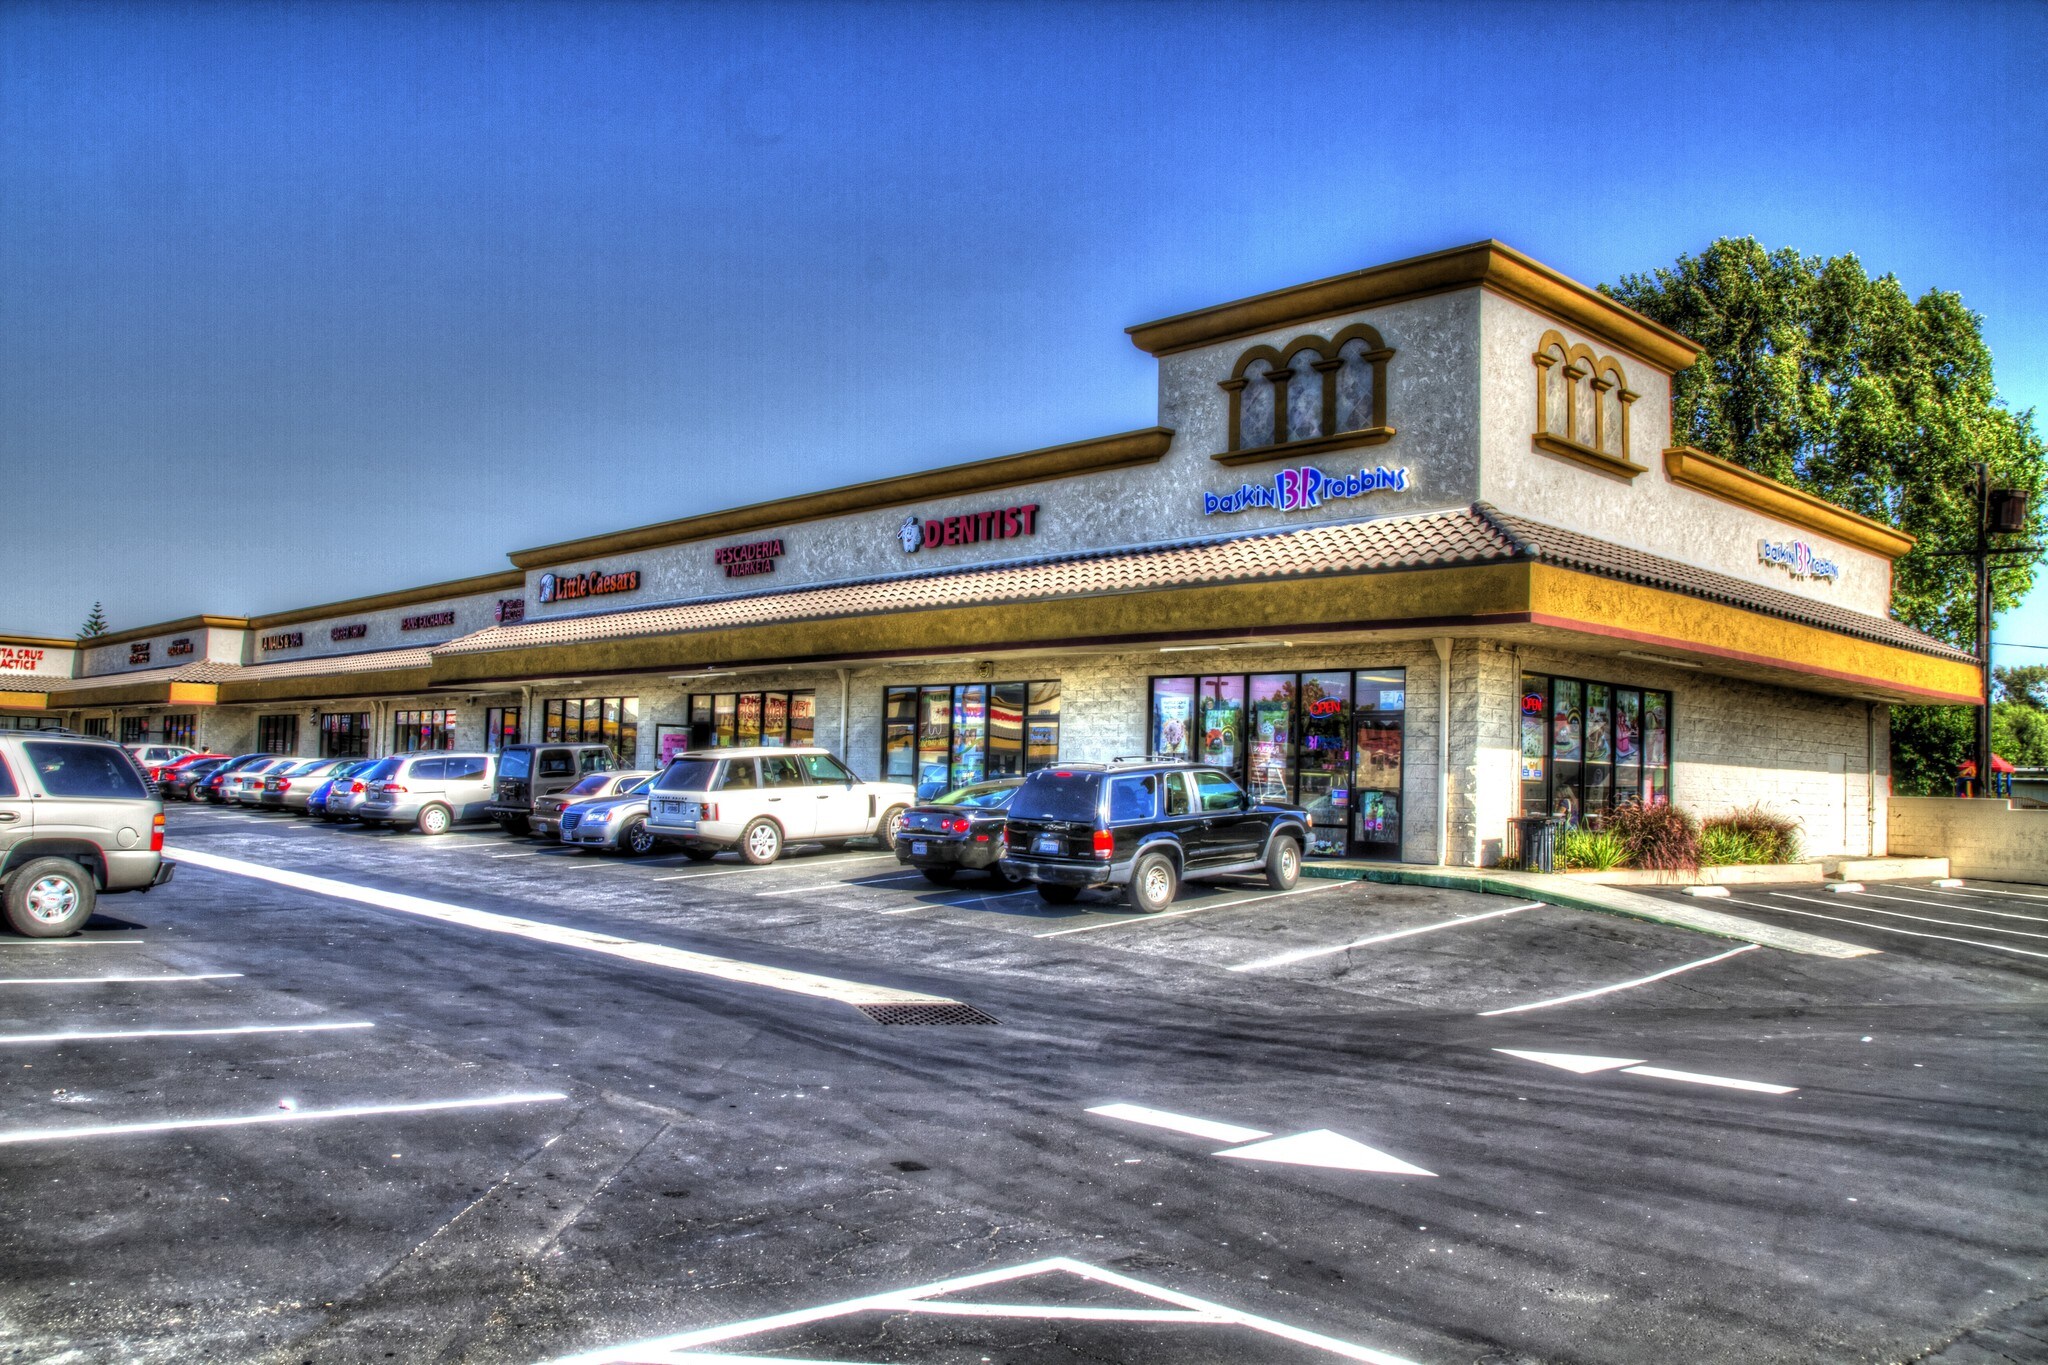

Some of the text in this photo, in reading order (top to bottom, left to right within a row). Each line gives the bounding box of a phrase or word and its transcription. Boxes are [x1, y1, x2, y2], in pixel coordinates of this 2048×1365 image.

[1204, 465, 1409, 515] baskin BR robbins
[924, 503, 1037, 548] DENTIST
[715, 539, 782, 564] PESCADERIA
[731, 559, 772, 577] MARKETA
[555, 570, 637, 600] Little Caesars
[0, 648, 44, 660] TA CRUZ
[1310, 701, 1341, 715] OPEN
[1522, 696, 1542, 712] OPEN
